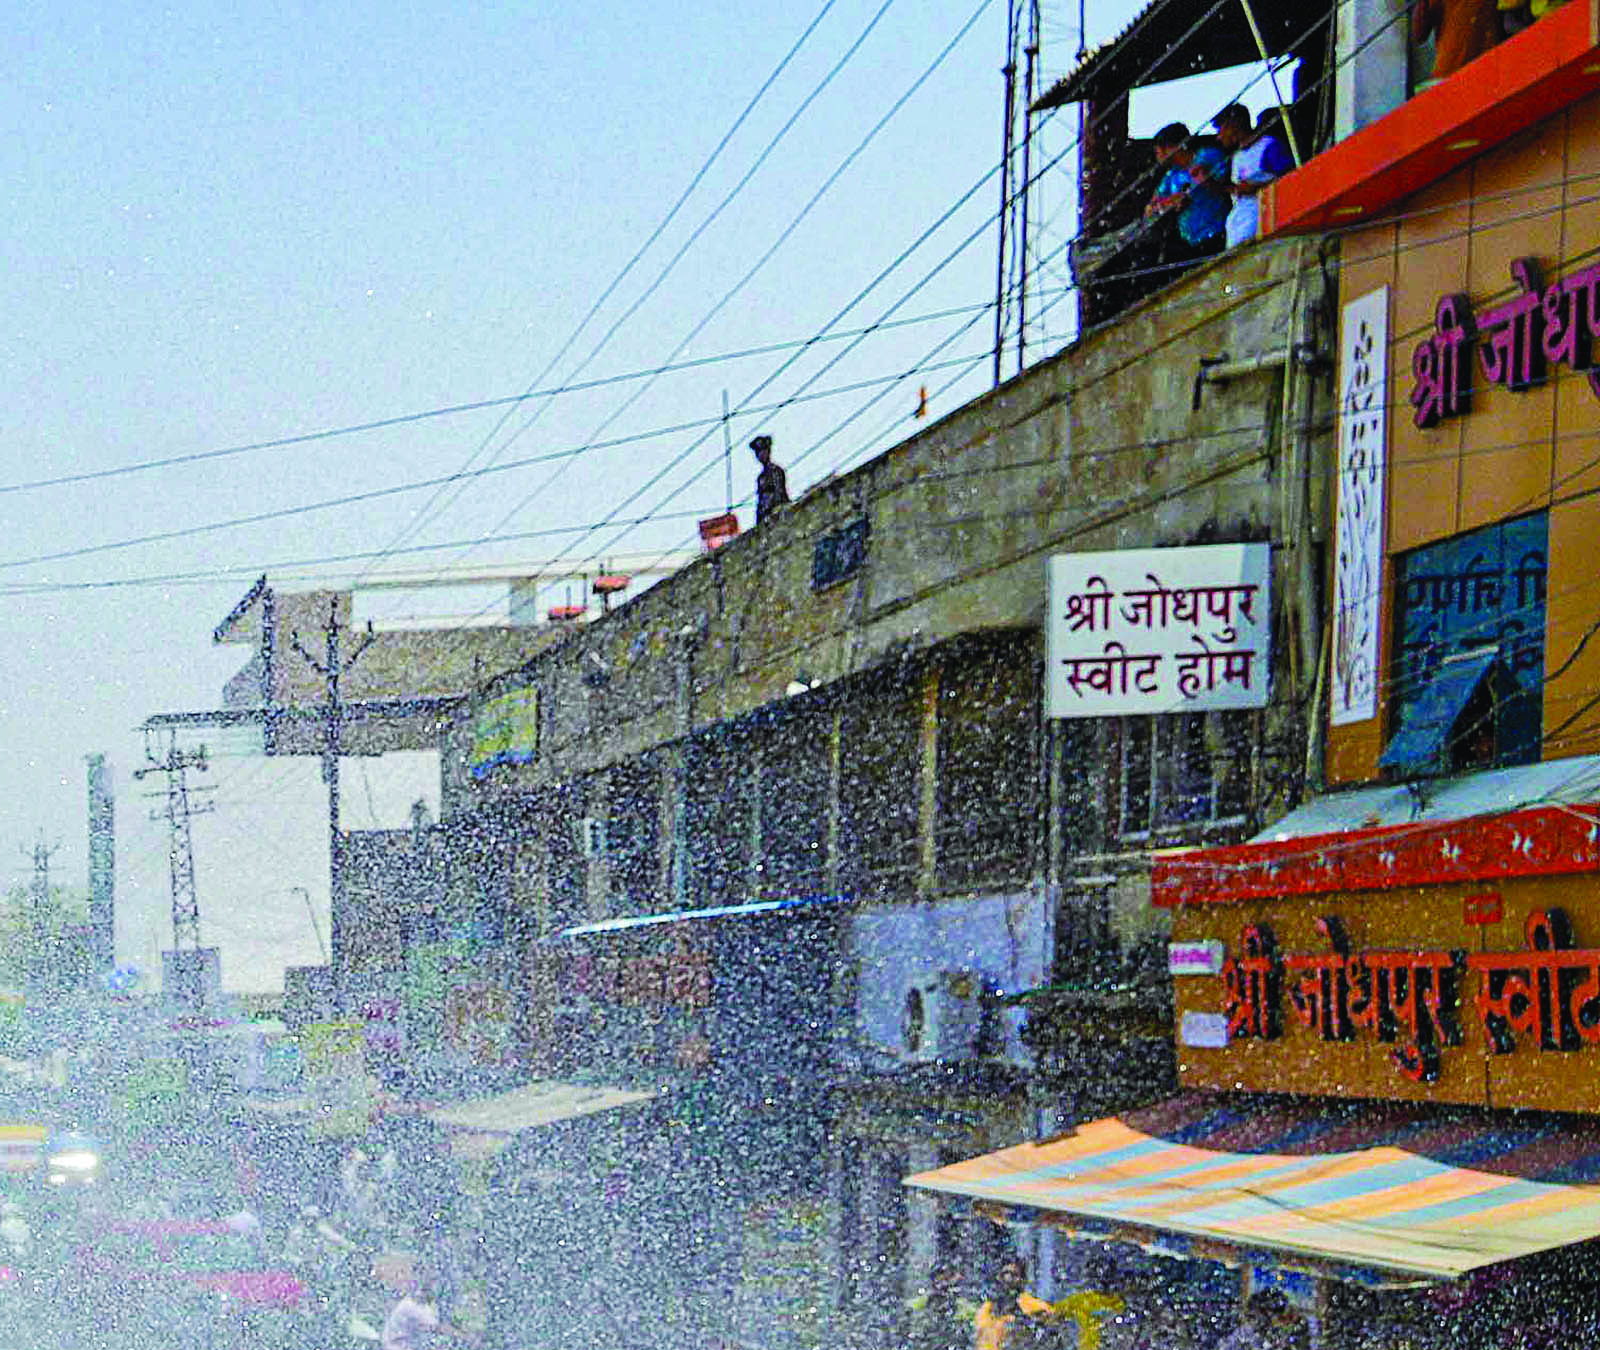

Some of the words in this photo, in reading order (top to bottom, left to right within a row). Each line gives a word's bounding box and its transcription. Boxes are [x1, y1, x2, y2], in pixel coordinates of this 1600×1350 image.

[1411, 289, 1474, 430] श्री
[1064, 576, 1115, 632] श्री
[1120, 573, 1259, 643] जोधपुर
[1062, 641, 1163, 698] स्वीट
[1174, 634, 1257, 700] होम
[1223, 923, 1280, 1040] श्री
[1284, 915, 1464, 1082] जोधपुर
